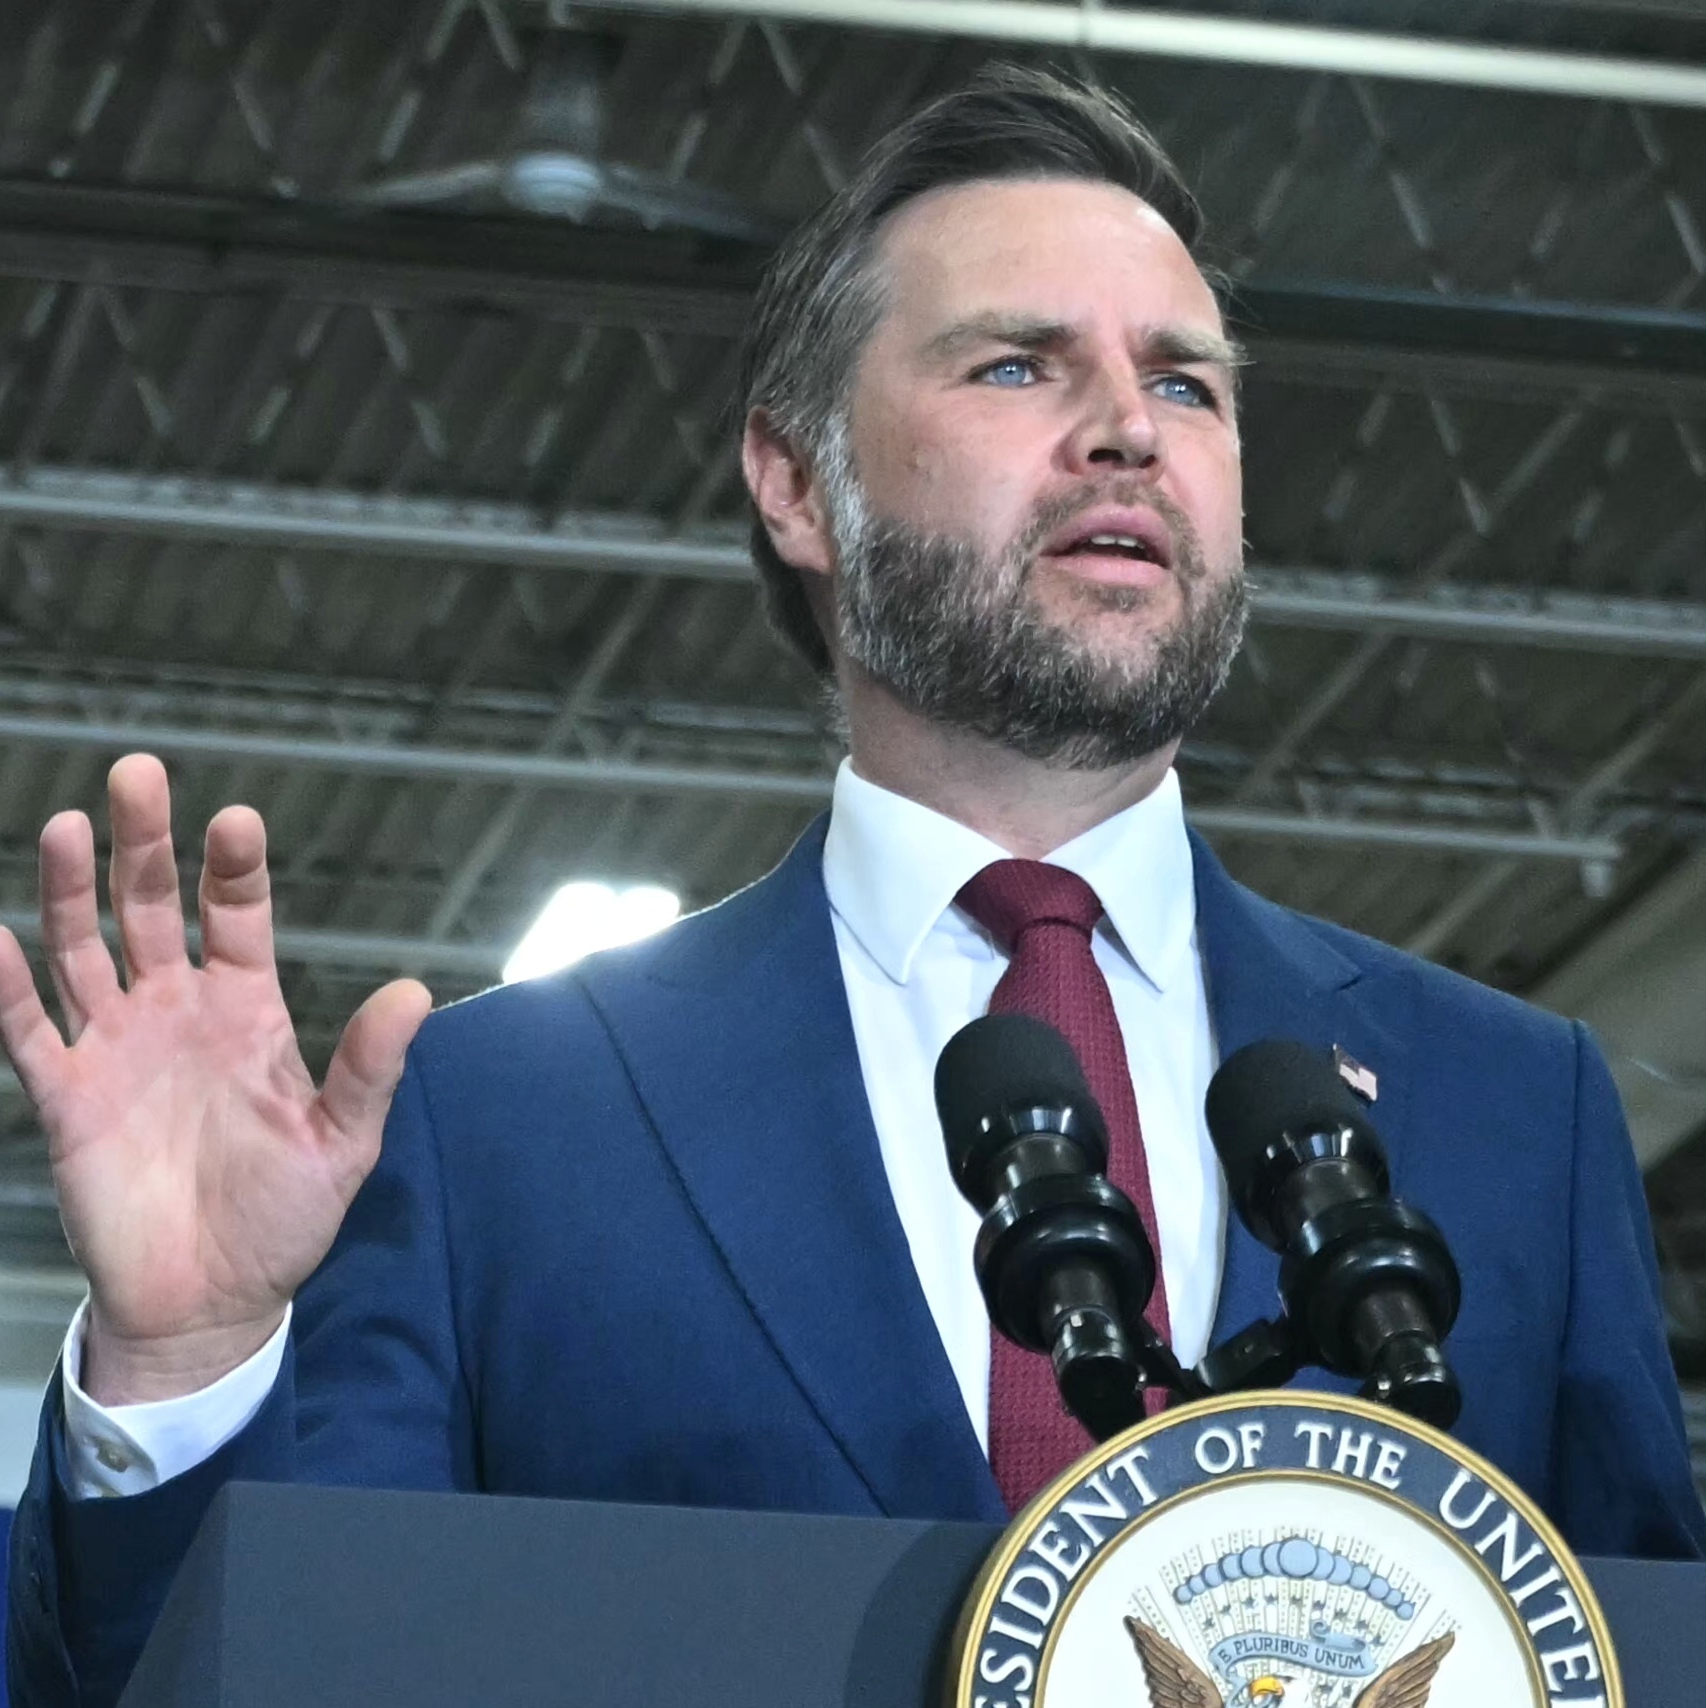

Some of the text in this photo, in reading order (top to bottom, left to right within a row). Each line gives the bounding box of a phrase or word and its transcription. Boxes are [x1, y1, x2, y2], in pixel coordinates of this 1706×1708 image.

[1194, 1420, 1265, 1475] OF
[1293, 1420, 1408, 1490] THE
[1218, 1637, 1365, 1670] E PLURIBUS UNUM
